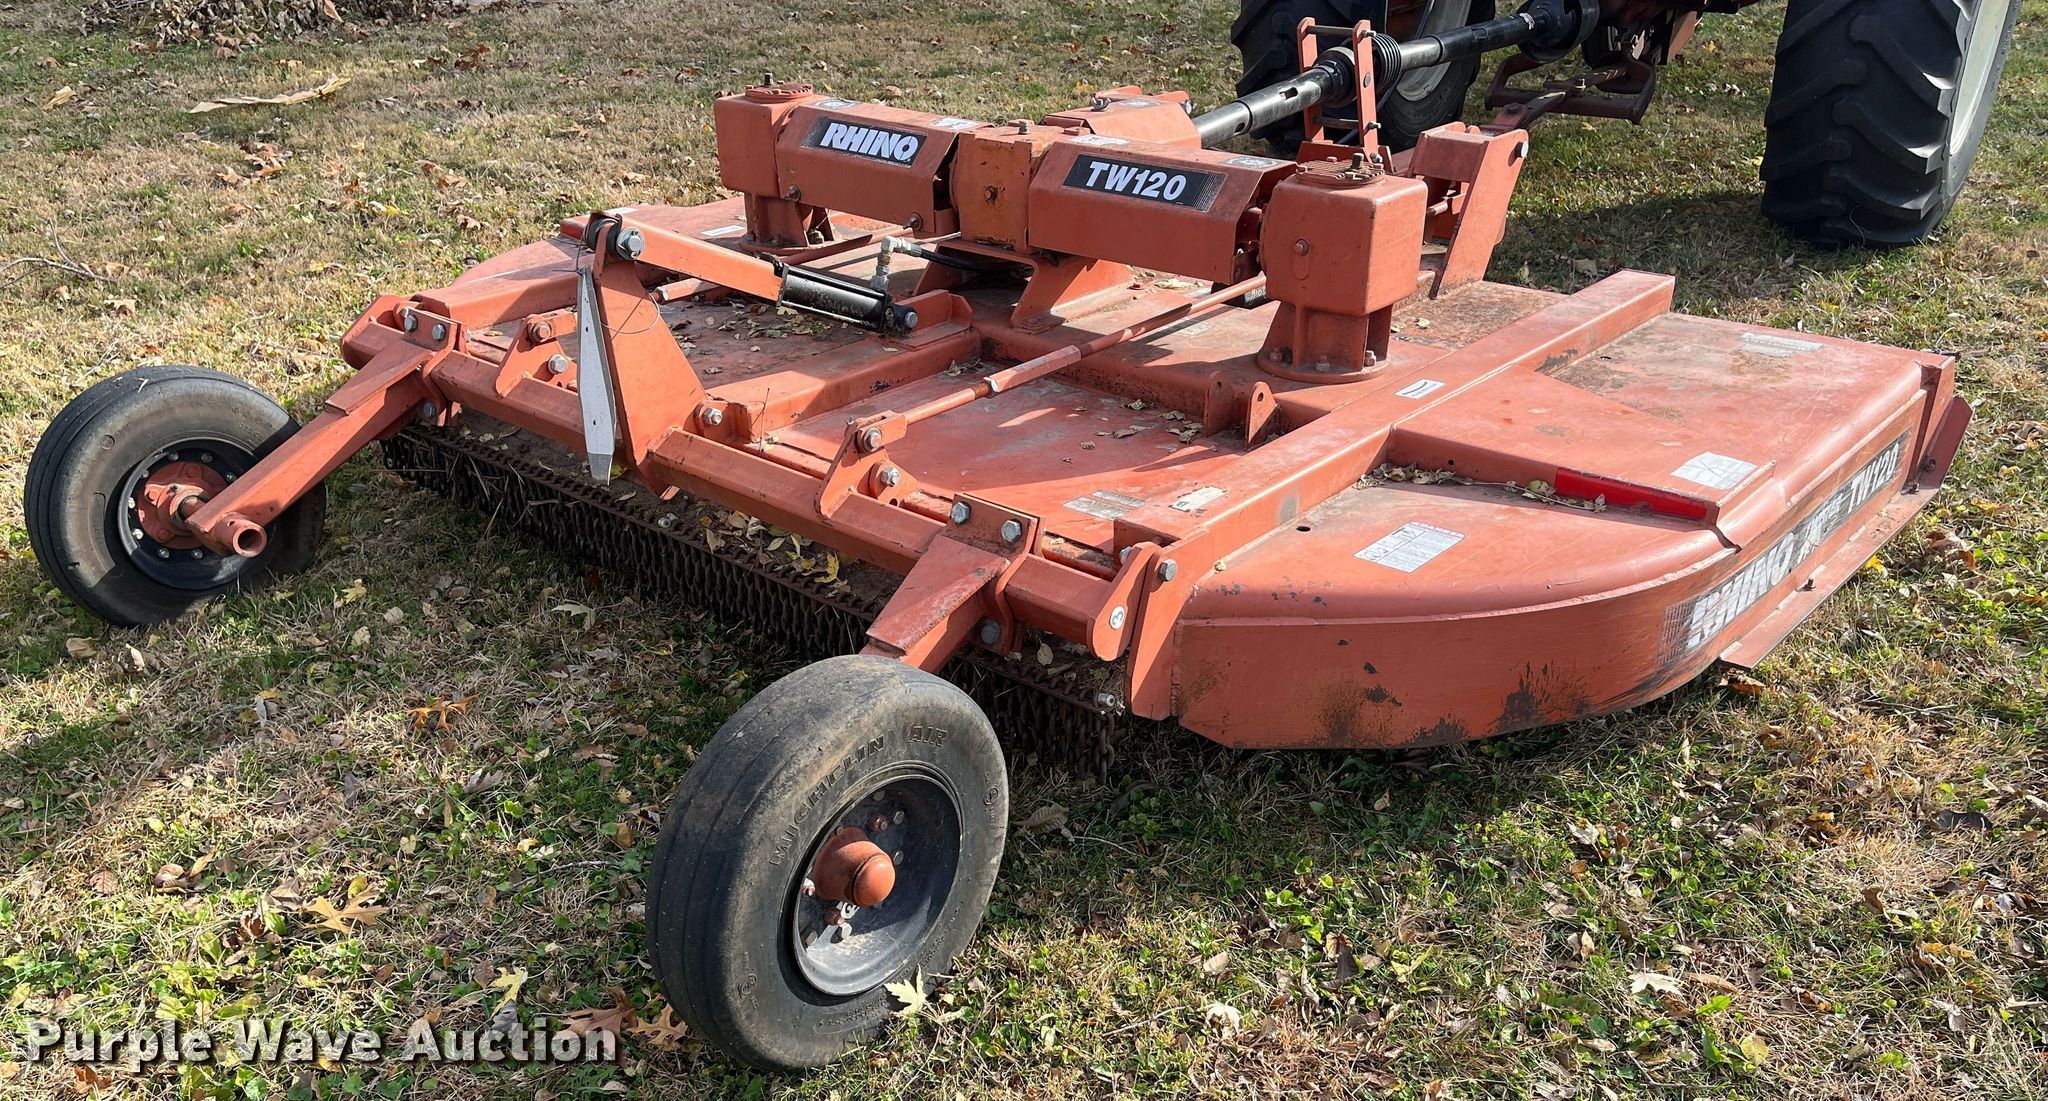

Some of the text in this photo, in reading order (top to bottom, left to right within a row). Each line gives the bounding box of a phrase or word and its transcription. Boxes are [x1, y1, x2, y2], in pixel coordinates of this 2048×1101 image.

[820, 122, 919, 161] RHINO
[1086, 161, 1187, 201] TW120
[907, 725, 948, 748] AIR
